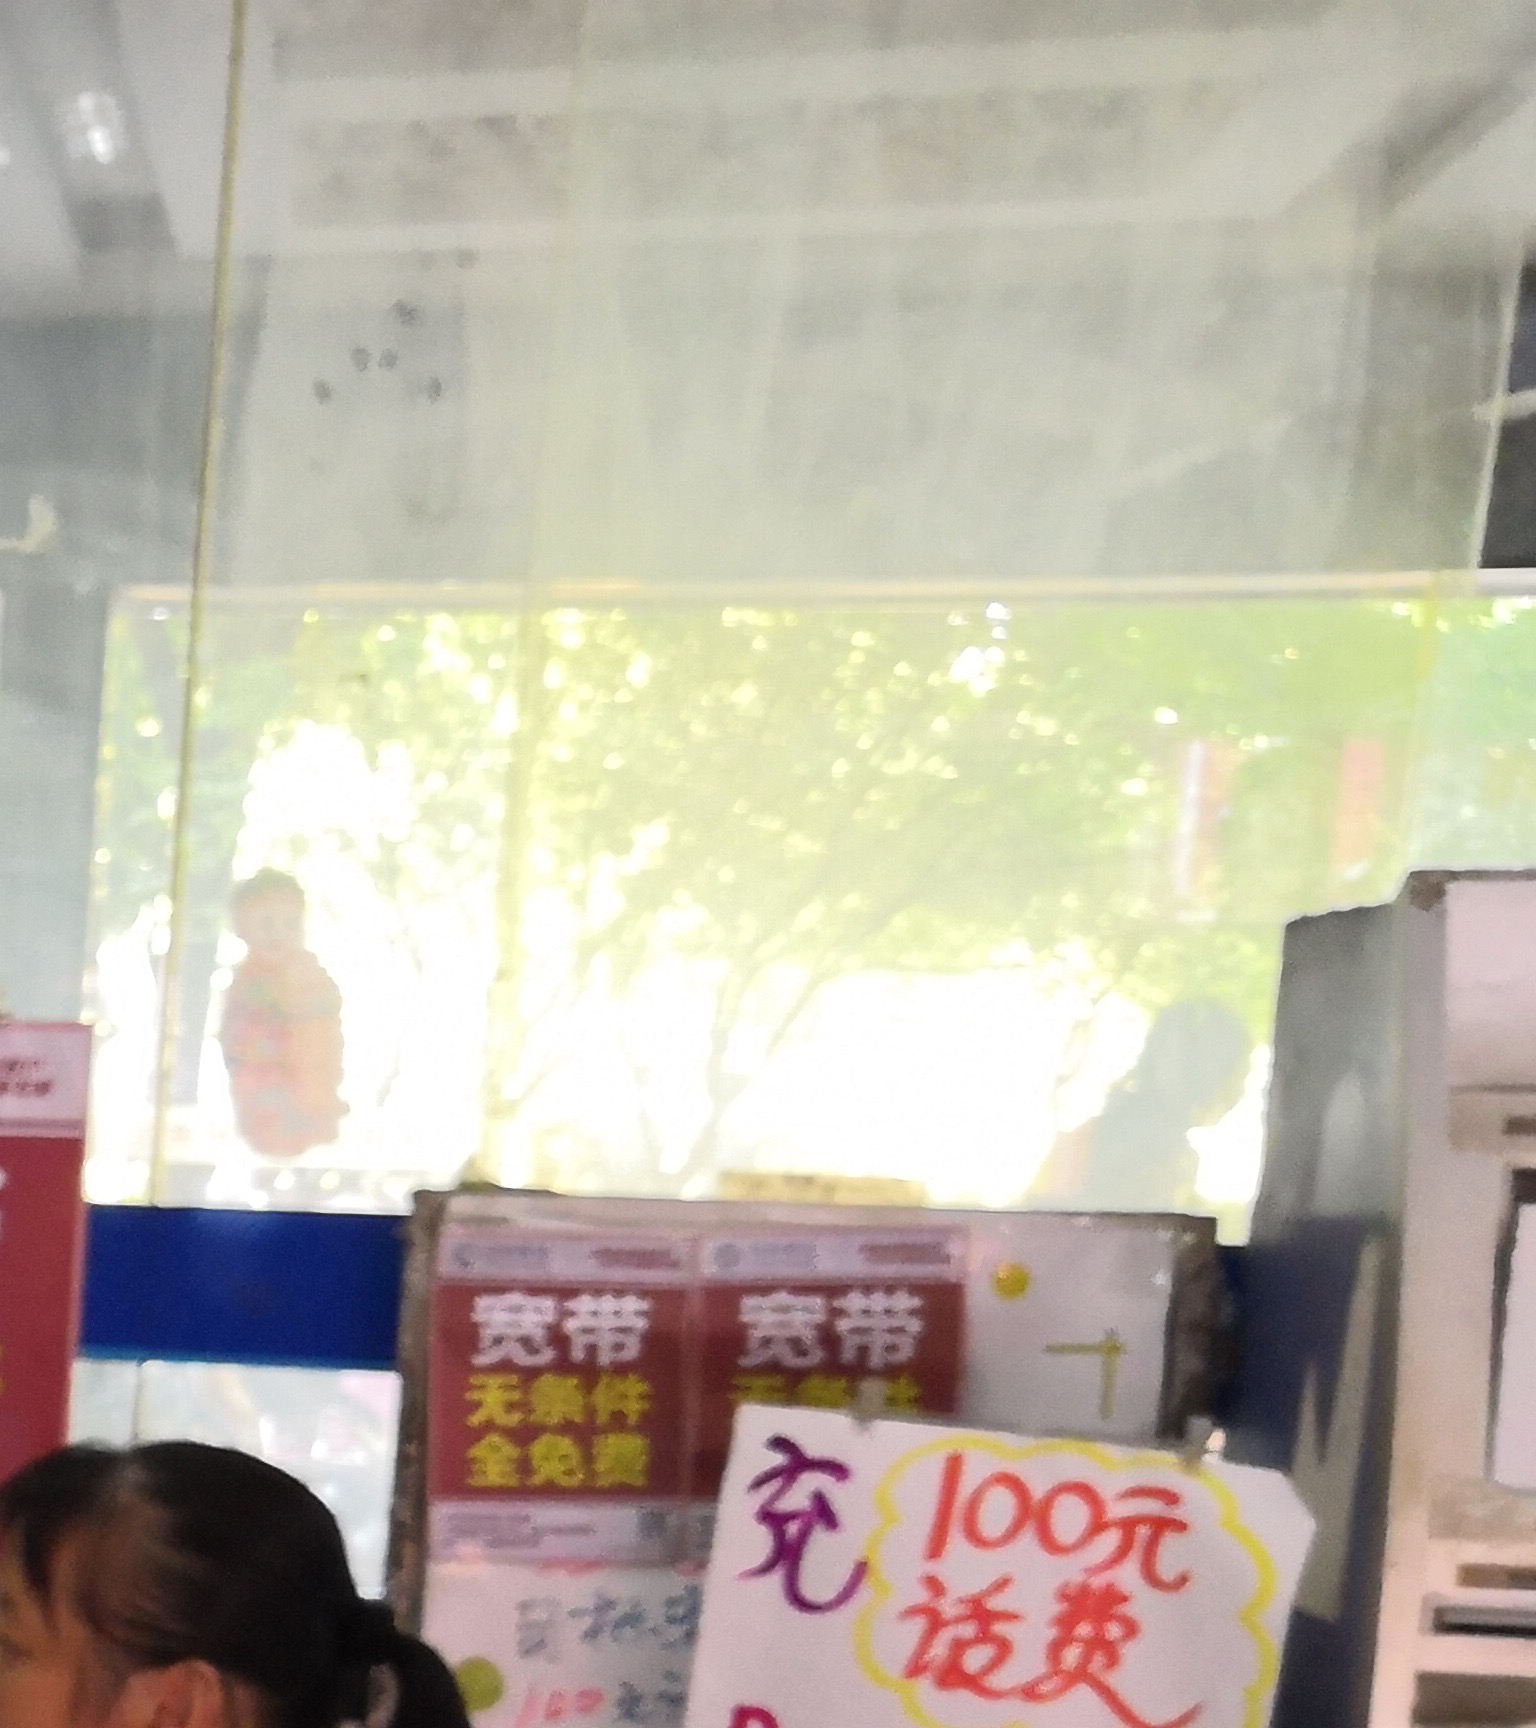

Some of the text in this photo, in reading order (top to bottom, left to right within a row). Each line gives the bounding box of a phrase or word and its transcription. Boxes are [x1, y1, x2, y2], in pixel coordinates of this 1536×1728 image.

[470, 1292, 651, 1367] 宽带
[738, 1289, 924, 1368] 宽带
[464, 1374, 650, 1427] 无条件
[746, 1434, 868, 1614] 充
[924, 1450, 1196, 1593] 100元
